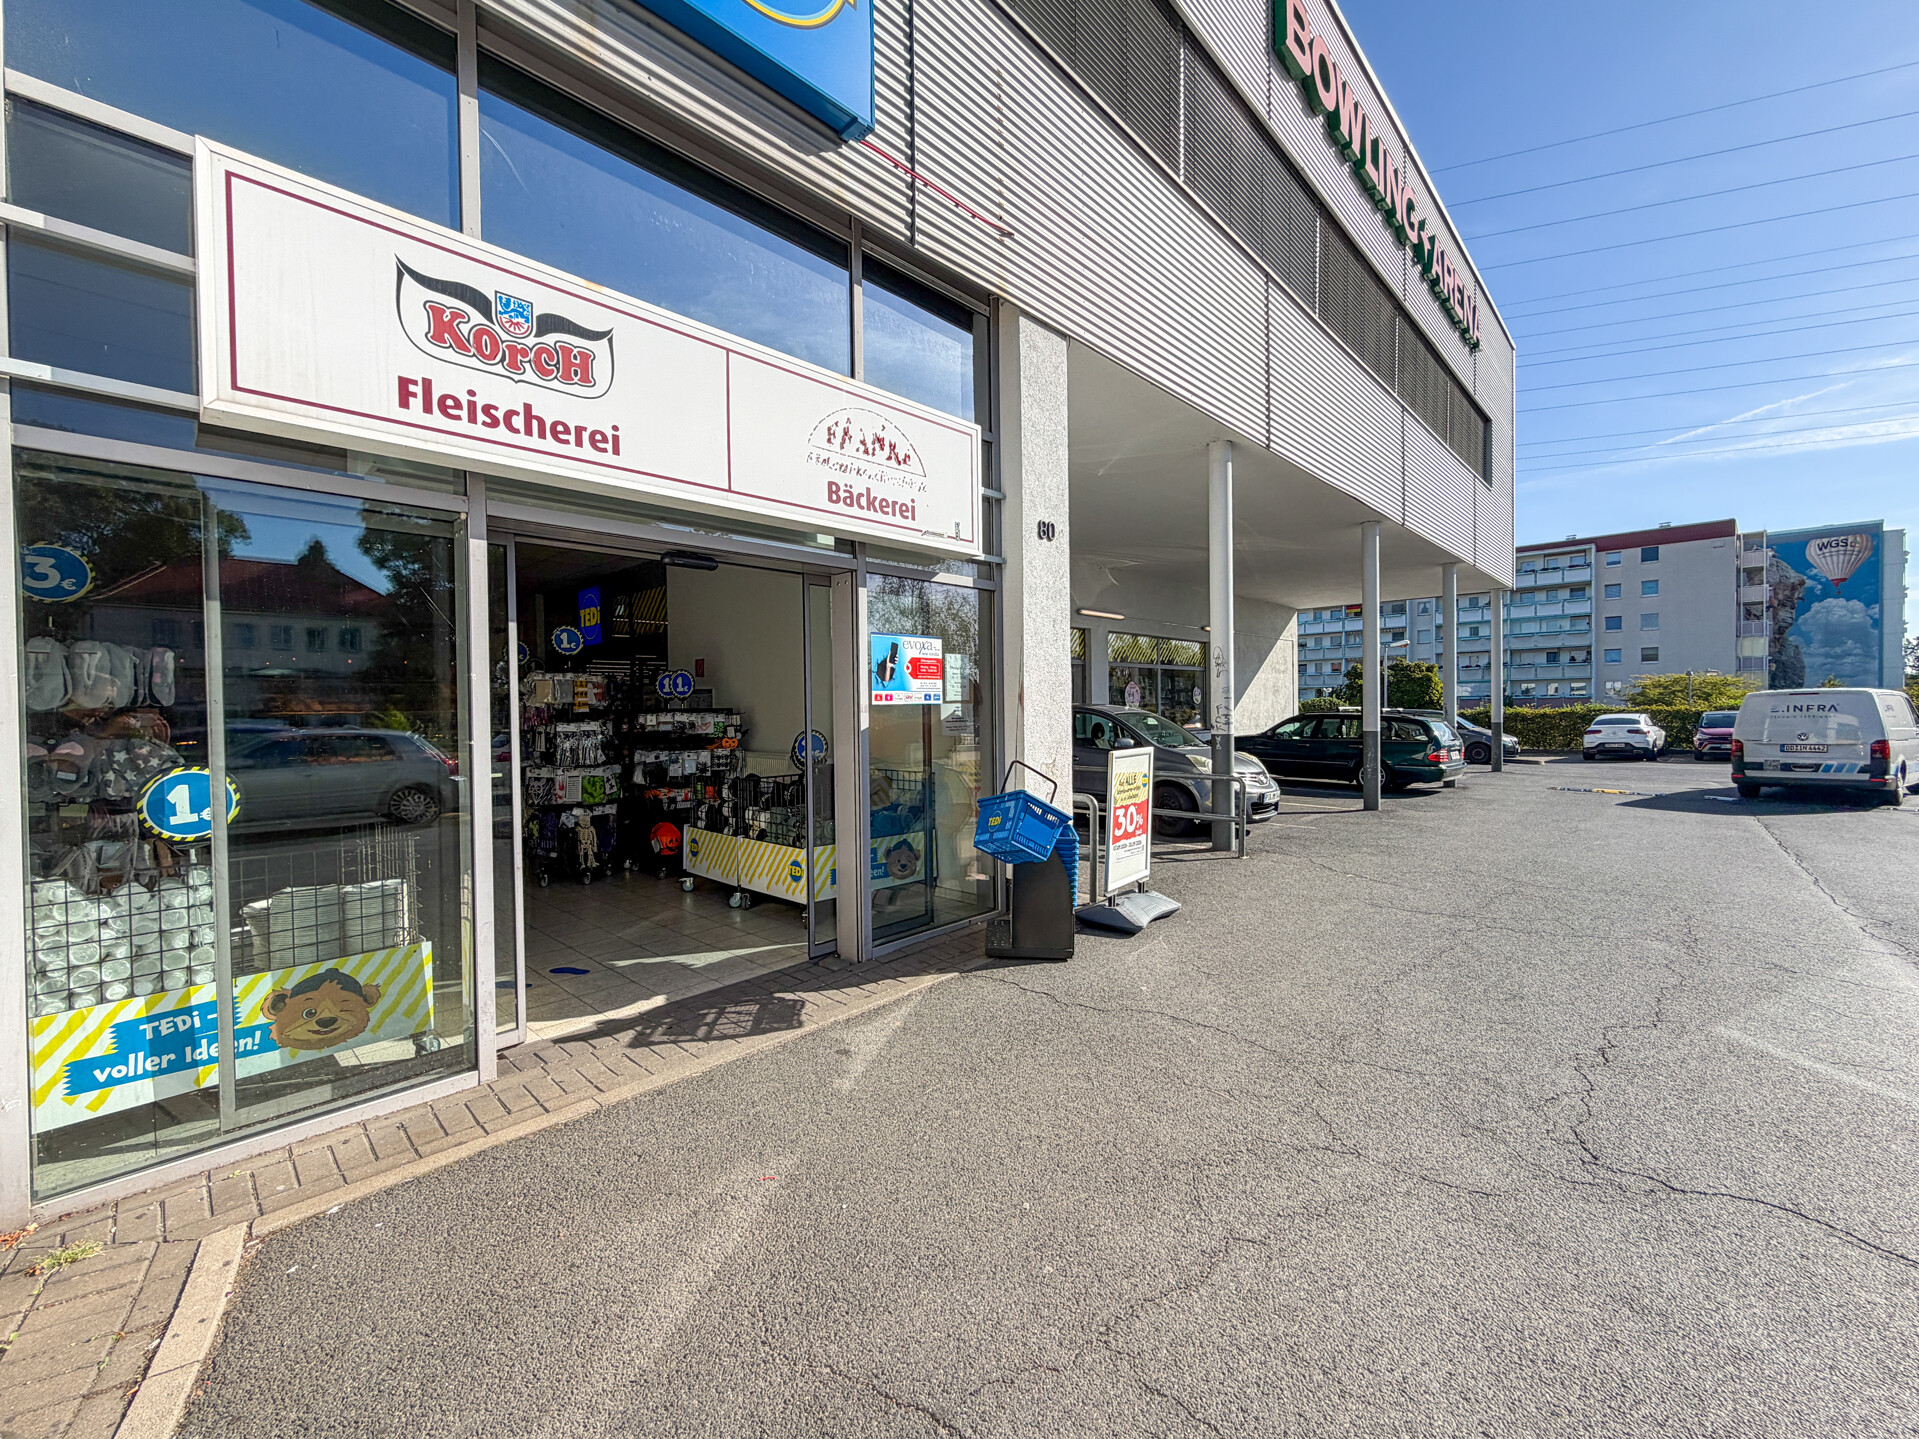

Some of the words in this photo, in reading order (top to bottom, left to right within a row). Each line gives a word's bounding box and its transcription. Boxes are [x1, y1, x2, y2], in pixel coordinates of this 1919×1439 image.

[1275, 0, 1419, 244] BOWLING
[1428, 235, 1482, 349] ARENA
[397, 375, 621, 457] Fleischerei
[827, 480, 916, 522] Bäckerei
[1037, 519, 1055, 542] 80
[1817, 538, 1849, 552] WGS
[580, 606, 600, 628] TEDi
[902, 640, 933, 654] evoxa
[139, 1011, 201, 1040] TEDi
[93, 1052, 176, 1083] voller
